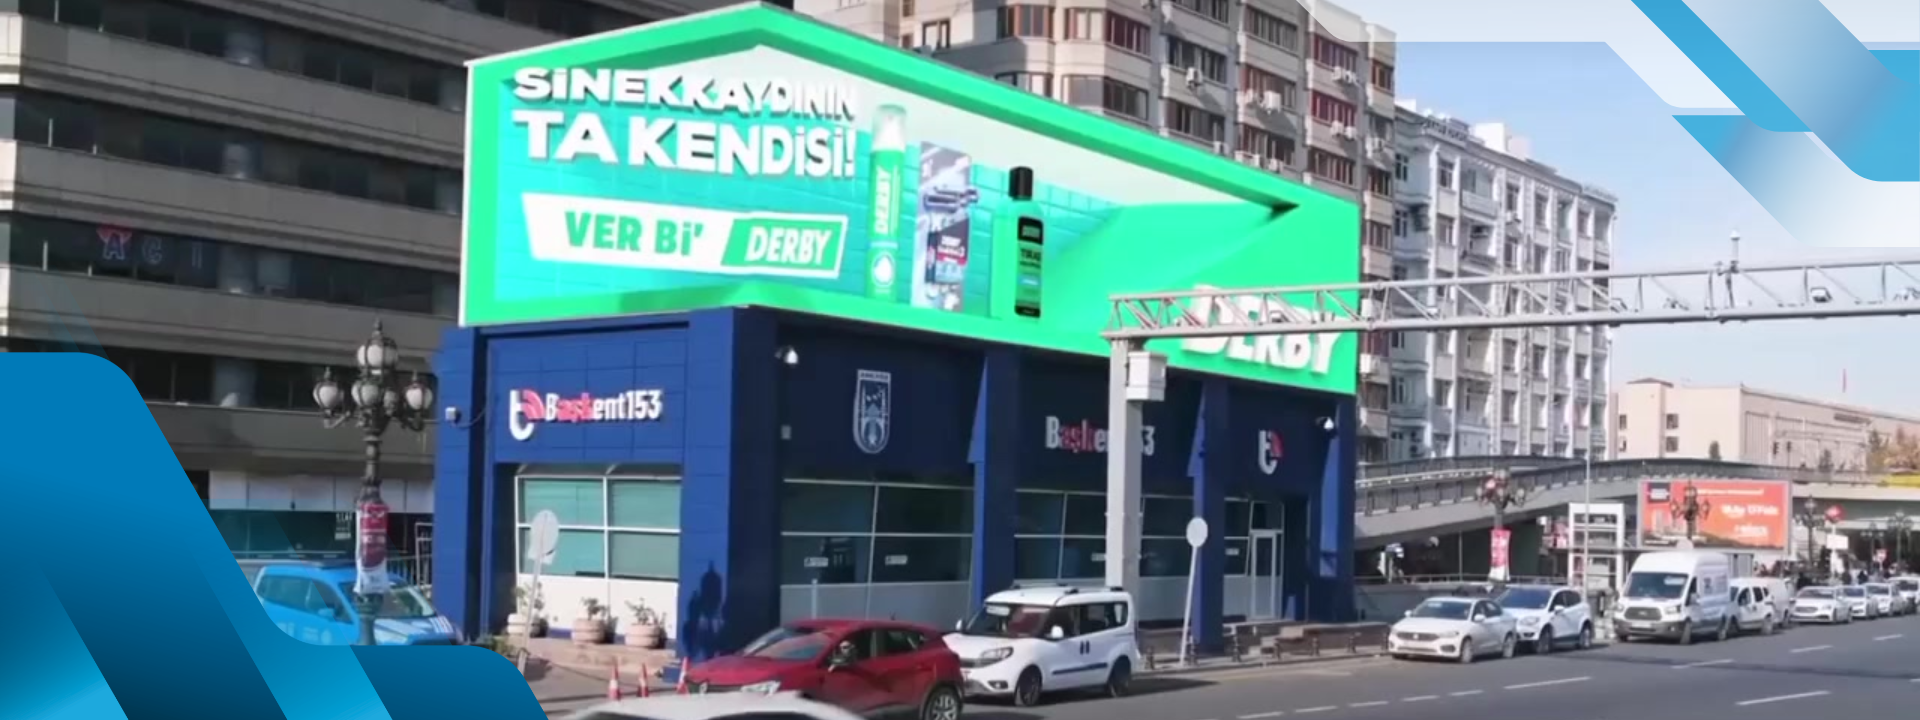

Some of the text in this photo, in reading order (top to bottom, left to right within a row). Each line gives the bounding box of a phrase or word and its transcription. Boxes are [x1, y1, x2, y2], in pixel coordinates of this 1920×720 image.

[511, 109, 618, 164] TA
[565, 211, 643, 252] VER
[745, 225, 832, 266] DERBY
